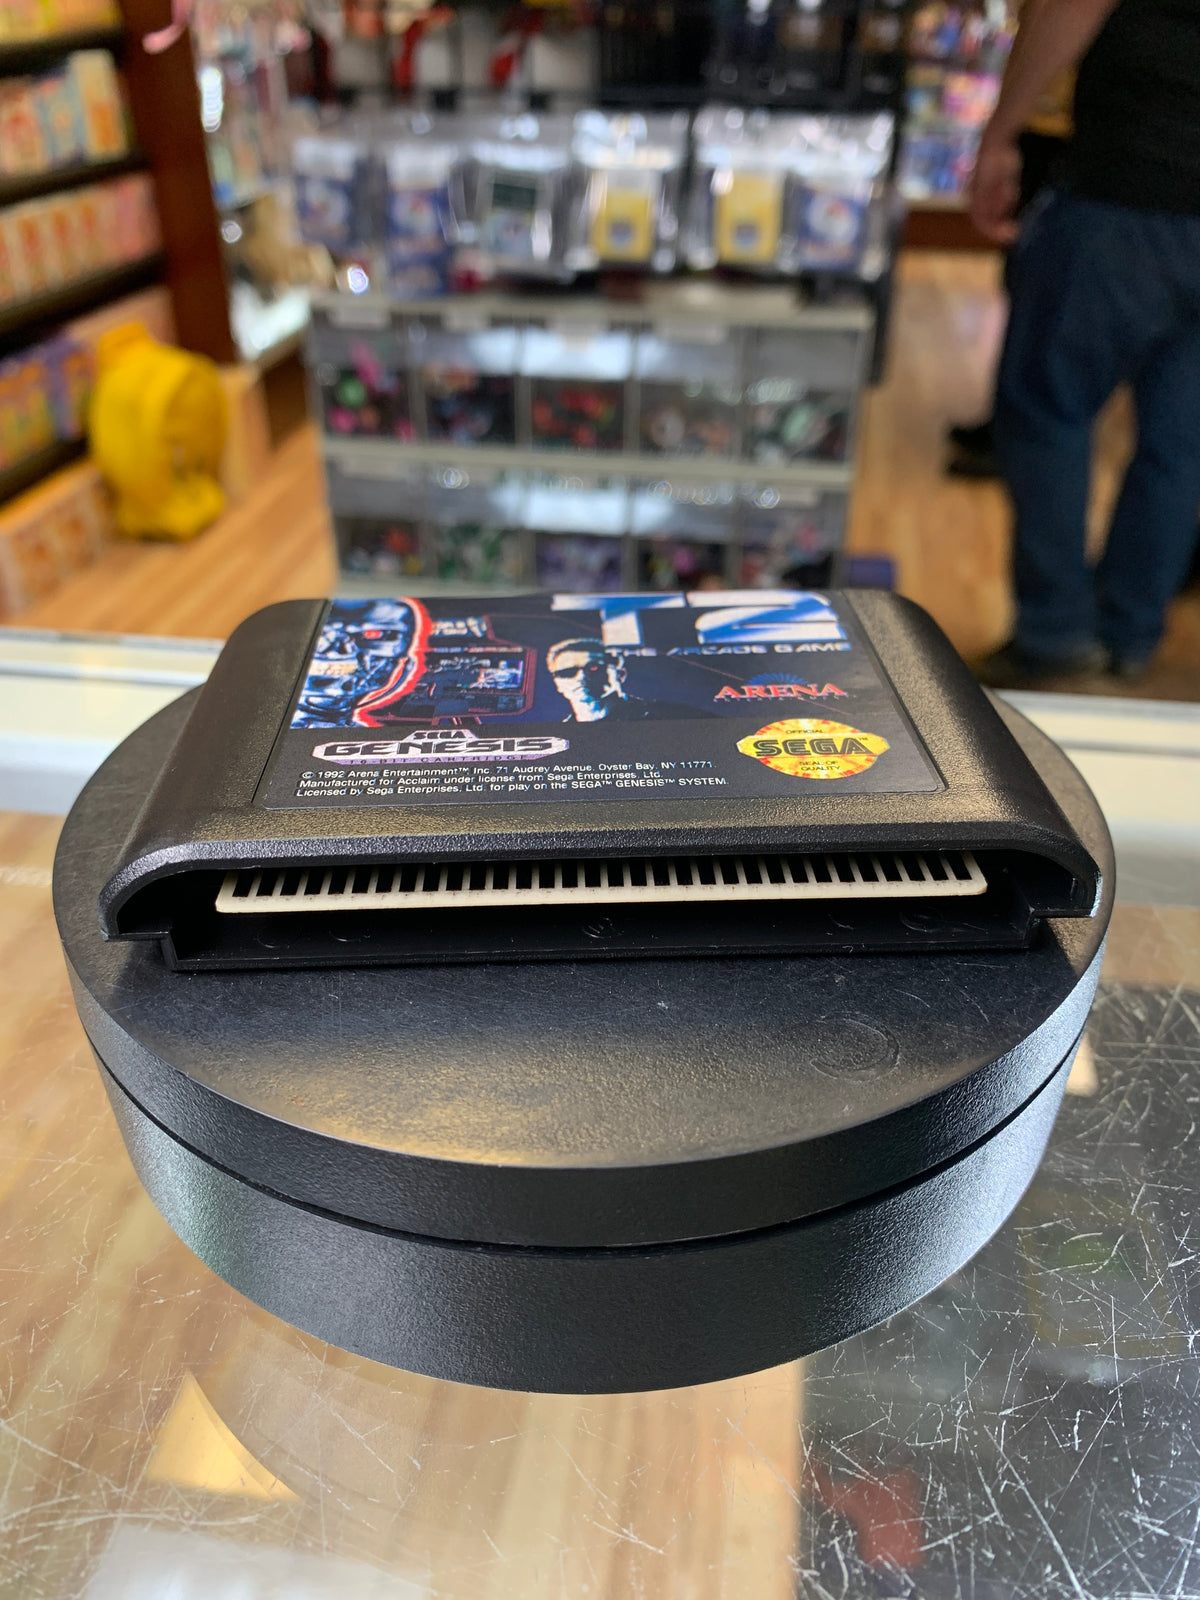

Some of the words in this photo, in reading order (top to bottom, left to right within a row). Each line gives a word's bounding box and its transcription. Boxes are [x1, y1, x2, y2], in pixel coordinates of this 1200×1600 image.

[551, 591, 848, 647] T2
[605, 648, 656, 657] THE
[667, 645, 767, 656] ARCADE
[774, 642, 852, 653] GAME
[714, 683, 848, 699] ARENA
[324, 738, 552, 756] GENESIS
[318, 771, 346, 779] 1992
[348, 770, 380, 778] Arena
[496, 766, 509, 774] 71
[512, 765, 550, 774] Audrey
[598, 763, 633, 773] Oyster
[661, 761, 677, 769] NY
[299, 779, 377, 788] Manufactured
[379, 778, 394, 786] for
[397, 776, 441, 785] Acclaim
[444, 775, 475, 784] under
[478, 774, 516, 783] license
[518, 774, 544, 782] from
[547, 773, 574, 782] Sega
[296, 788, 347, 797] Licensed
[350, 788, 364, 797] by
[366, 786, 394, 796] Sega
[490, 783, 505, 792] for
[508, 782, 531, 792] play
[534, 782, 548, 790] on
[551, 781, 568, 789] the
